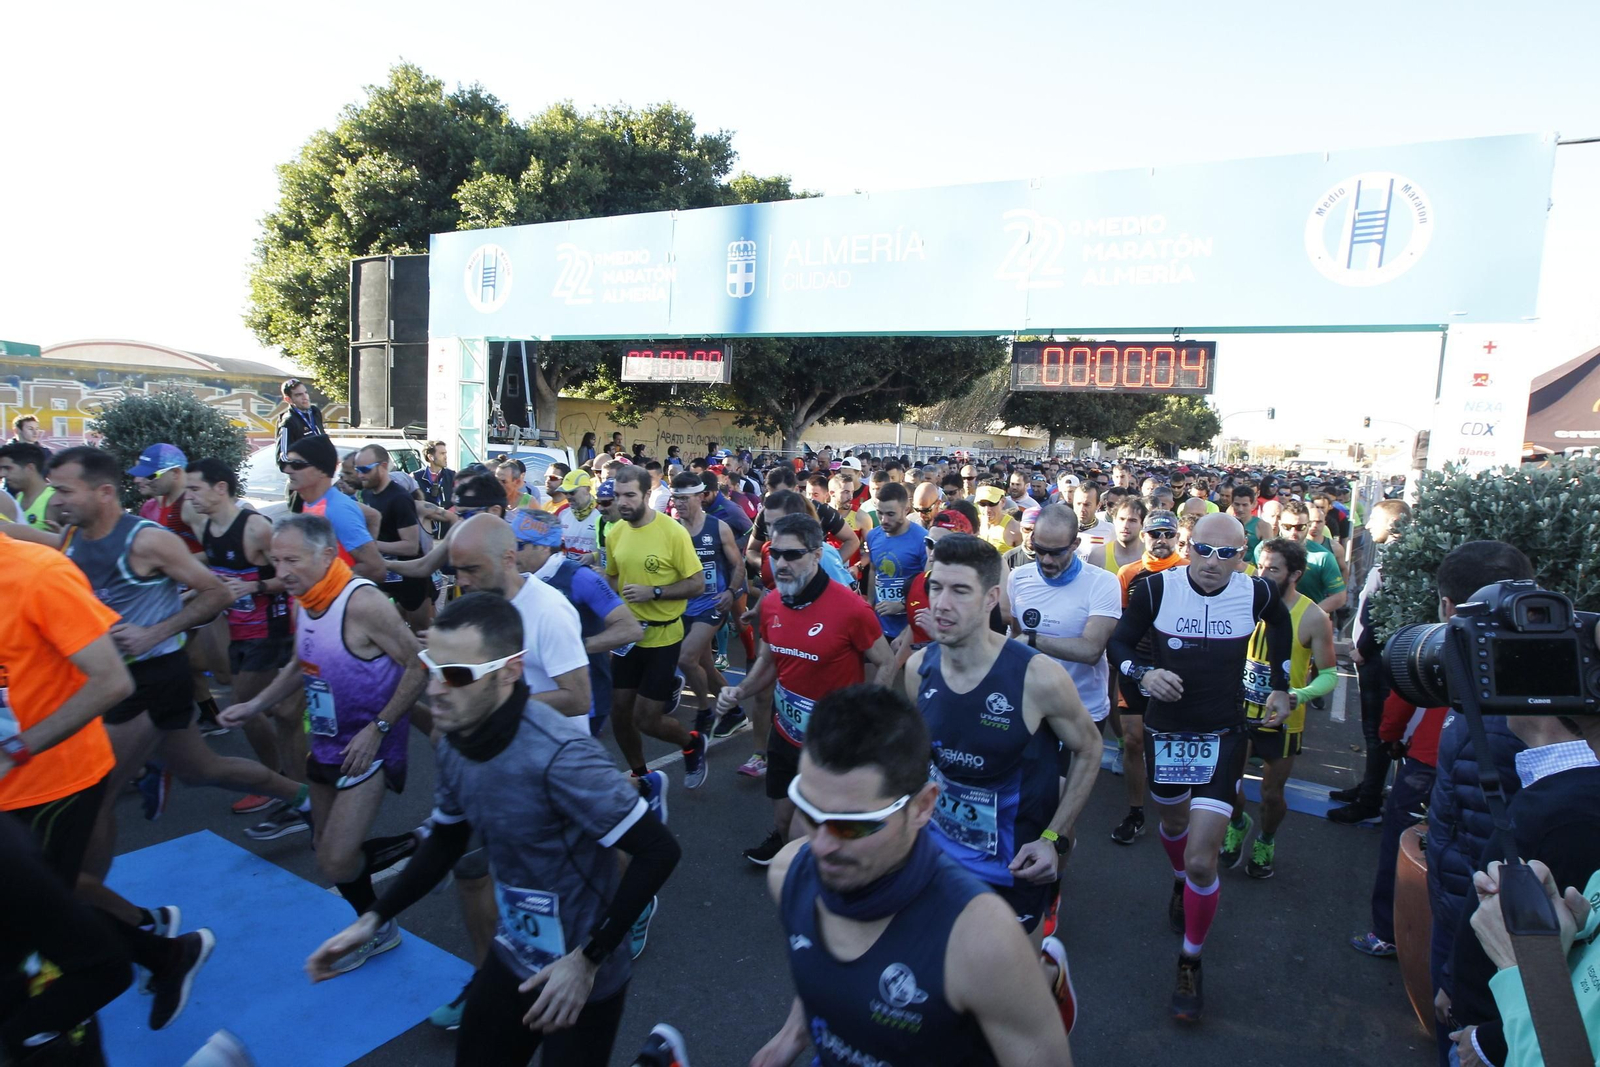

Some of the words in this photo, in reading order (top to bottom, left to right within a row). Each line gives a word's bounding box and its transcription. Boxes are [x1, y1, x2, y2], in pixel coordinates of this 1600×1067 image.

[1315, 187, 1346, 217] Medio
[1083, 214, 1167, 238] MEDIO
[603, 248, 651, 266] MEDIO
[783, 225, 926, 268] ALMERÍA
[1082, 232, 1214, 262] MARATÓN
[602, 263, 677, 285] MARATÓN
[781, 270, 851, 290] CIUDAD
[1081, 259, 1197, 288] ALMERÍA
[602, 282, 668, 303] ALMERÍA
[1042, 346, 1206, 388] 00:00:04
[1463, 401, 1502, 413] NEXA
[1460, 421, 1496, 436] CDX
[1457, 447, 1497, 457] Blanes
[1175, 617, 1233, 635] CARLITOS
[780, 699, 802, 724] 186
[1163, 741, 1212, 759] 1306
